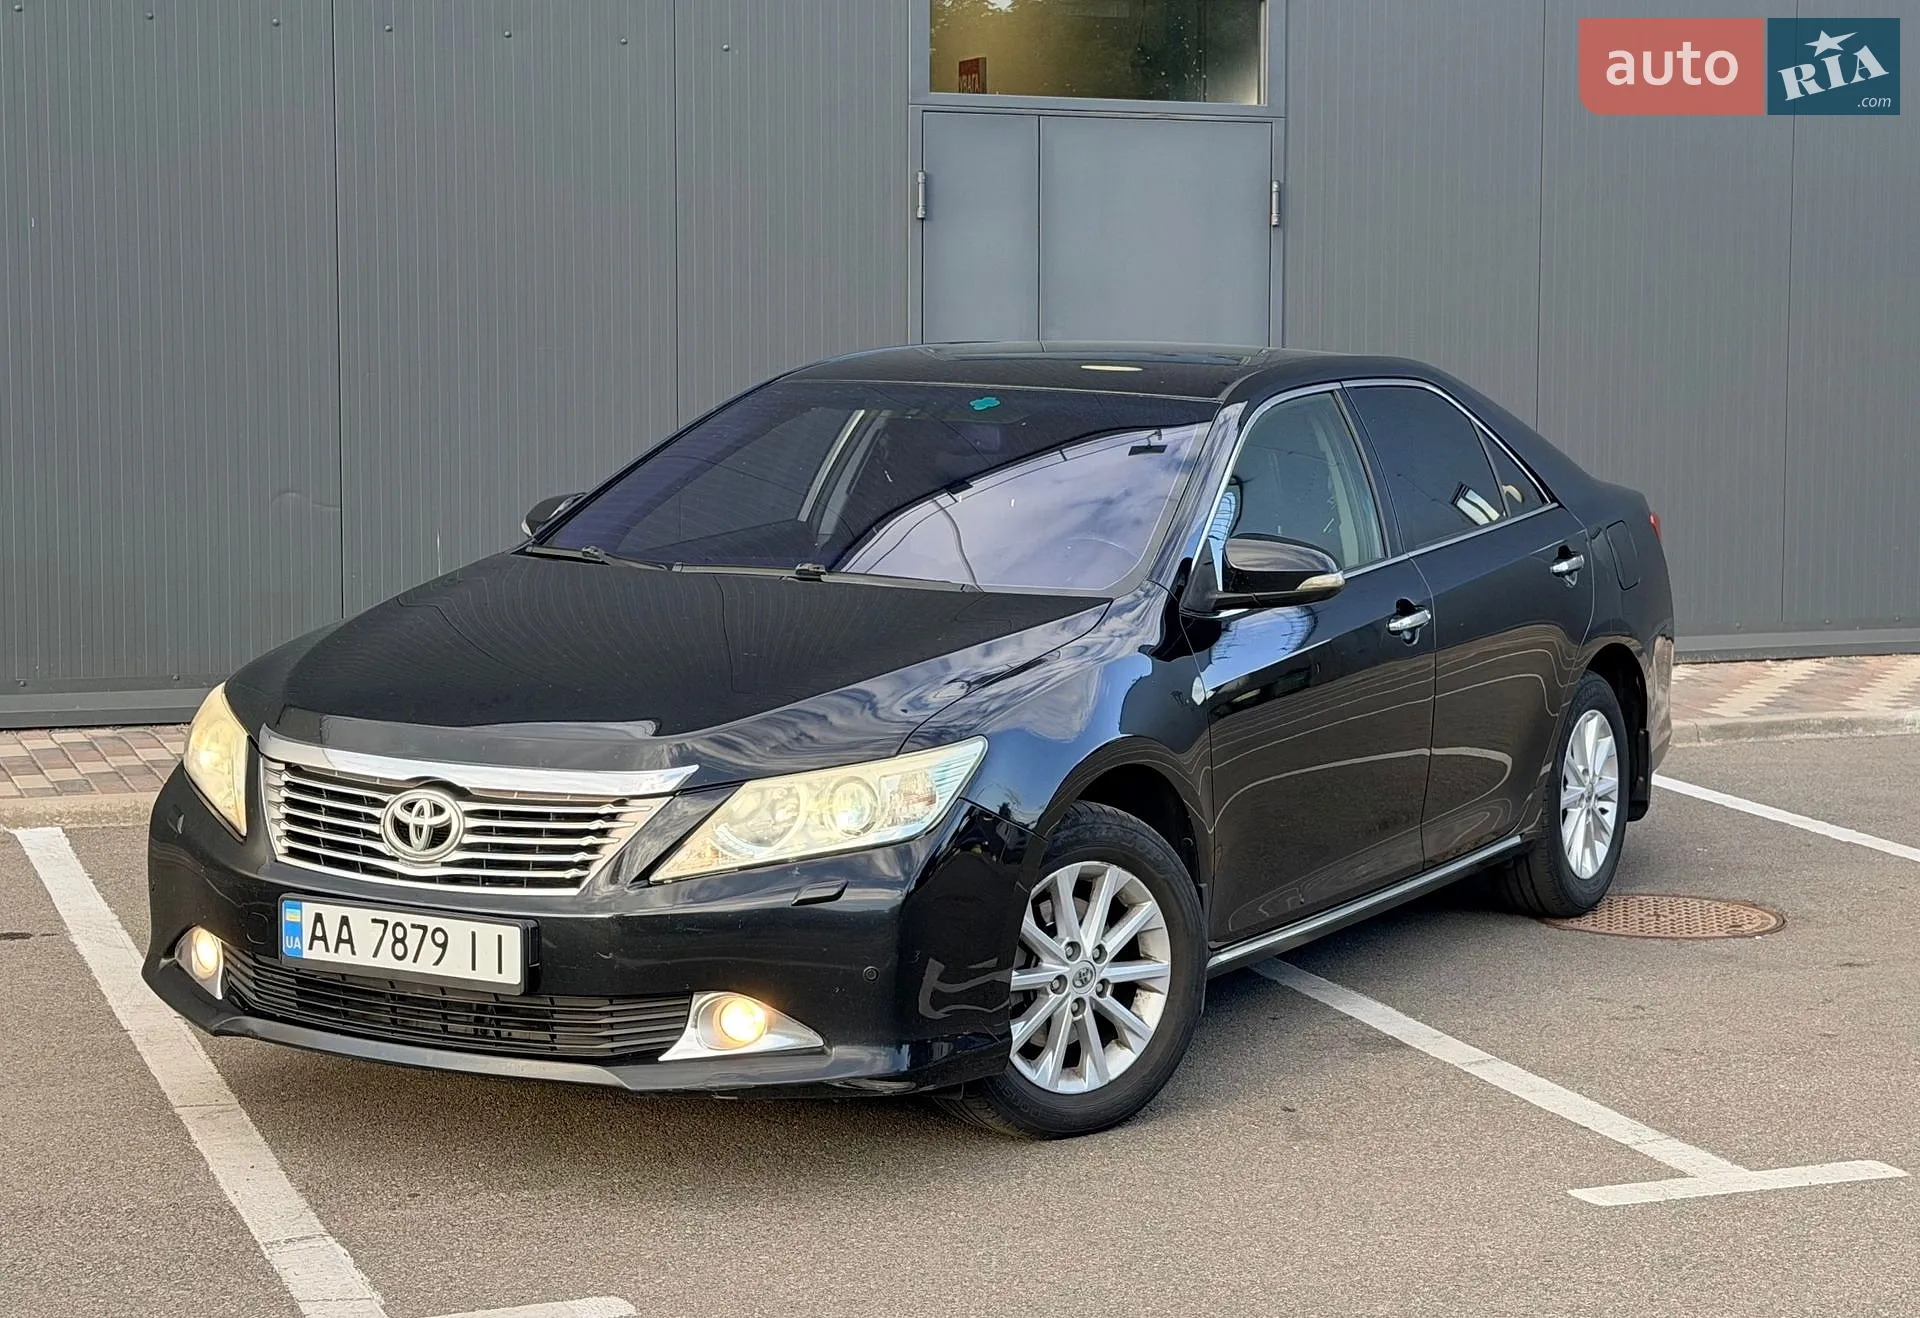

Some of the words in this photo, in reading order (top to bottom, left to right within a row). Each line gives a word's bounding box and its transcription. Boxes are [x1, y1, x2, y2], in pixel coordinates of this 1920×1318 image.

[285, 935, 302, 949] UA
[308, 912, 356, 956] AA
[371, 918, 449, 966] 7879
